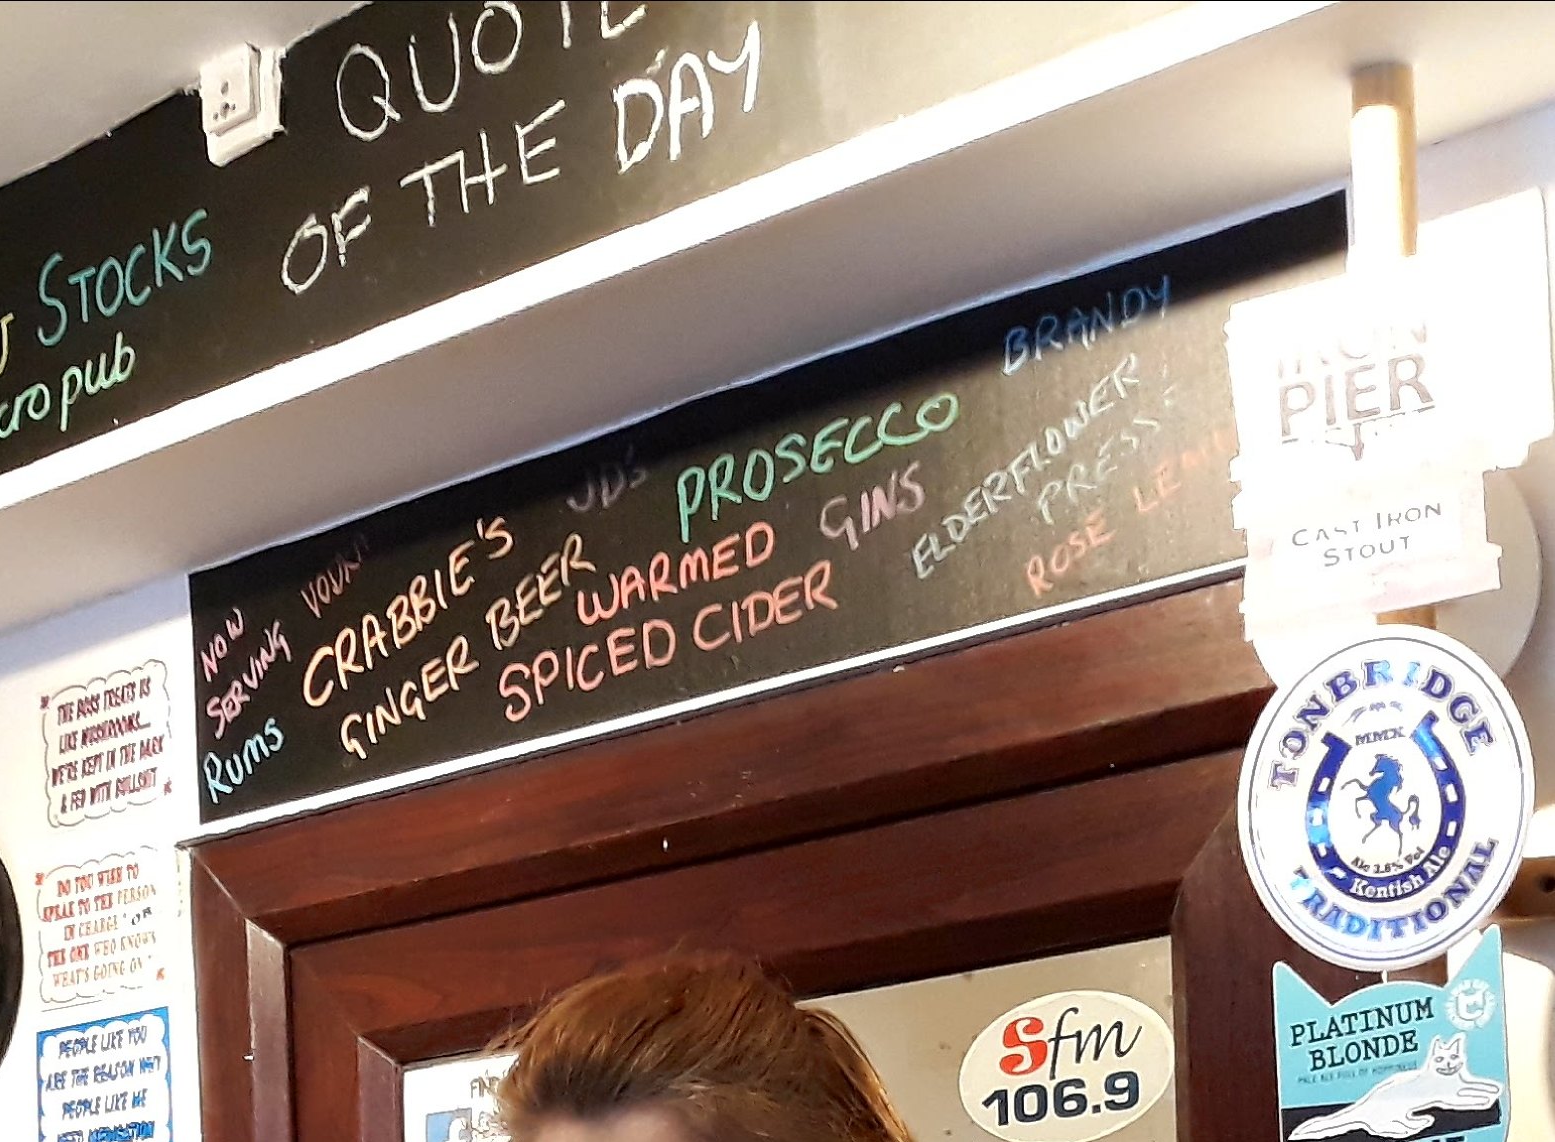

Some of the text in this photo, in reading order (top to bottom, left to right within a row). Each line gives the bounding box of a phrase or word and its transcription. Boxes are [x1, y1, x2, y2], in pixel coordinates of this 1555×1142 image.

[281, 20, 762, 294] OF THE DAY
[1000, 275, 1171, 376] BRANDY
[1279, 354, 1434, 437] PIER
[676, 393, 960, 544] PROSECCO
[818, 461, 927, 551] GINS
[910, 352, 1141, 580] ELDERFLOWER
[576, 521, 776, 627] WARMED
[1324, 535, 1410, 567] STOUT
[200, 606, 245, 682] NOW
[302, 517, 514, 708] CRABBIE'S
[340, 532, 597, 761] GINGER BEER
[498, 560, 839, 723] SPICED CIDER
[206, 618, 295, 739] SERVING
[1267, 658, 1497, 791] TONBRIDGE
[117, 884, 157, 905] PERSON
[1290, 837, 1500, 941] TRADITIONAL
[1350, 846, 1451, 898] Kentish Ale
[100, 1028, 124, 1052] LIKE
[128, 1025, 148, 1046] YOU
[1290, 997, 1435, 1046] PLATINUM
[1308, 1030, 1419, 1072] BLONDE
[45, 1070, 68, 1092] ARE
[71, 1066, 90, 1088] THE
[93, 1059, 135, 1083] REASON
[62, 1096, 102, 1120] PEOPLE
[104, 1091, 129, 1114] LIKE
[982, 1071, 1140, 1127] 106.9
